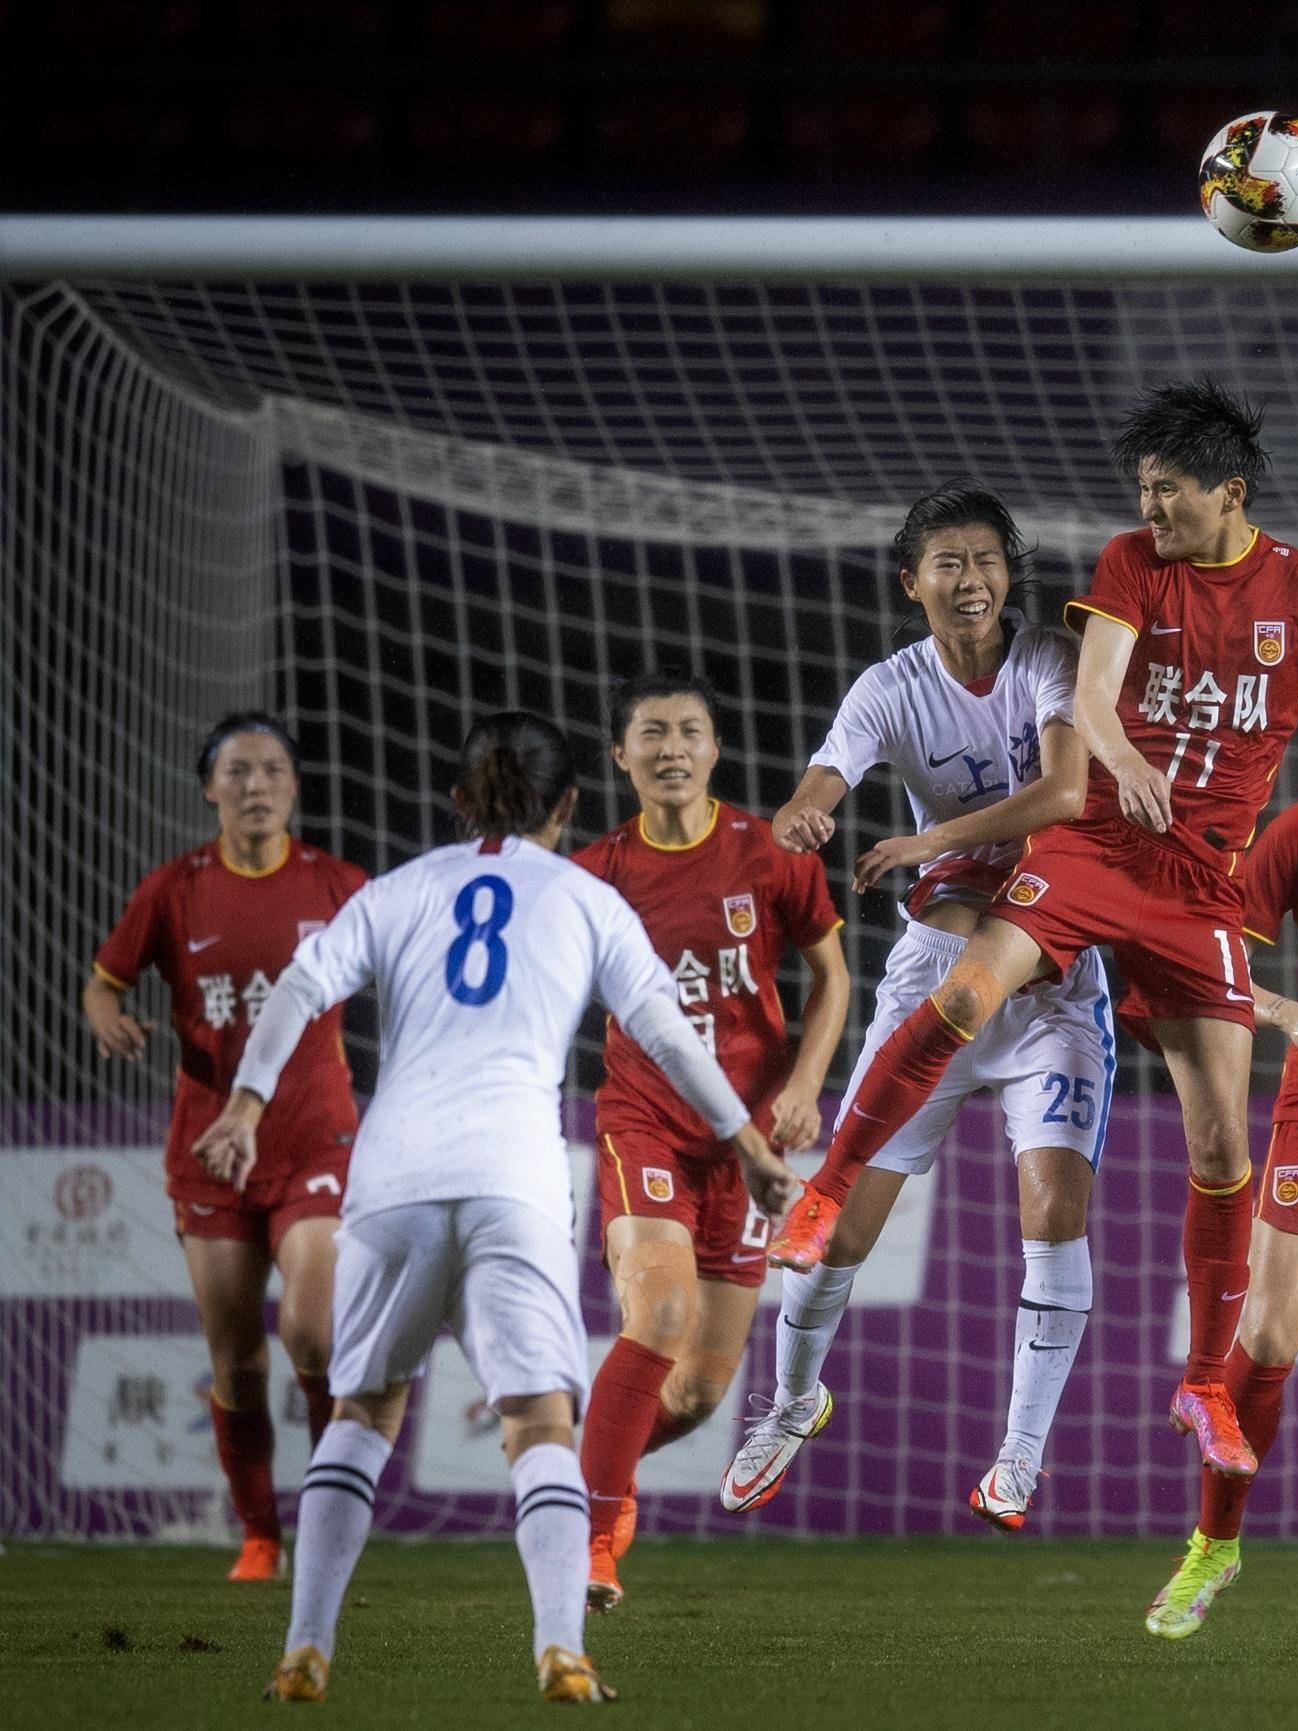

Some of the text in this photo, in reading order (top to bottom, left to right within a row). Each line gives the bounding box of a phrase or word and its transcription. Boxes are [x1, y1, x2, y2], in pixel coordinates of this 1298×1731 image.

[1138, 662, 1269, 734] 联合队
[1166, 732, 1222, 788] 11
[445, 874, 515, 1007] 8
[197, 969, 290, 1030] 联合
[672, 943, 759, 1007] 合队
[1042, 1072, 1096, 1131] 25
